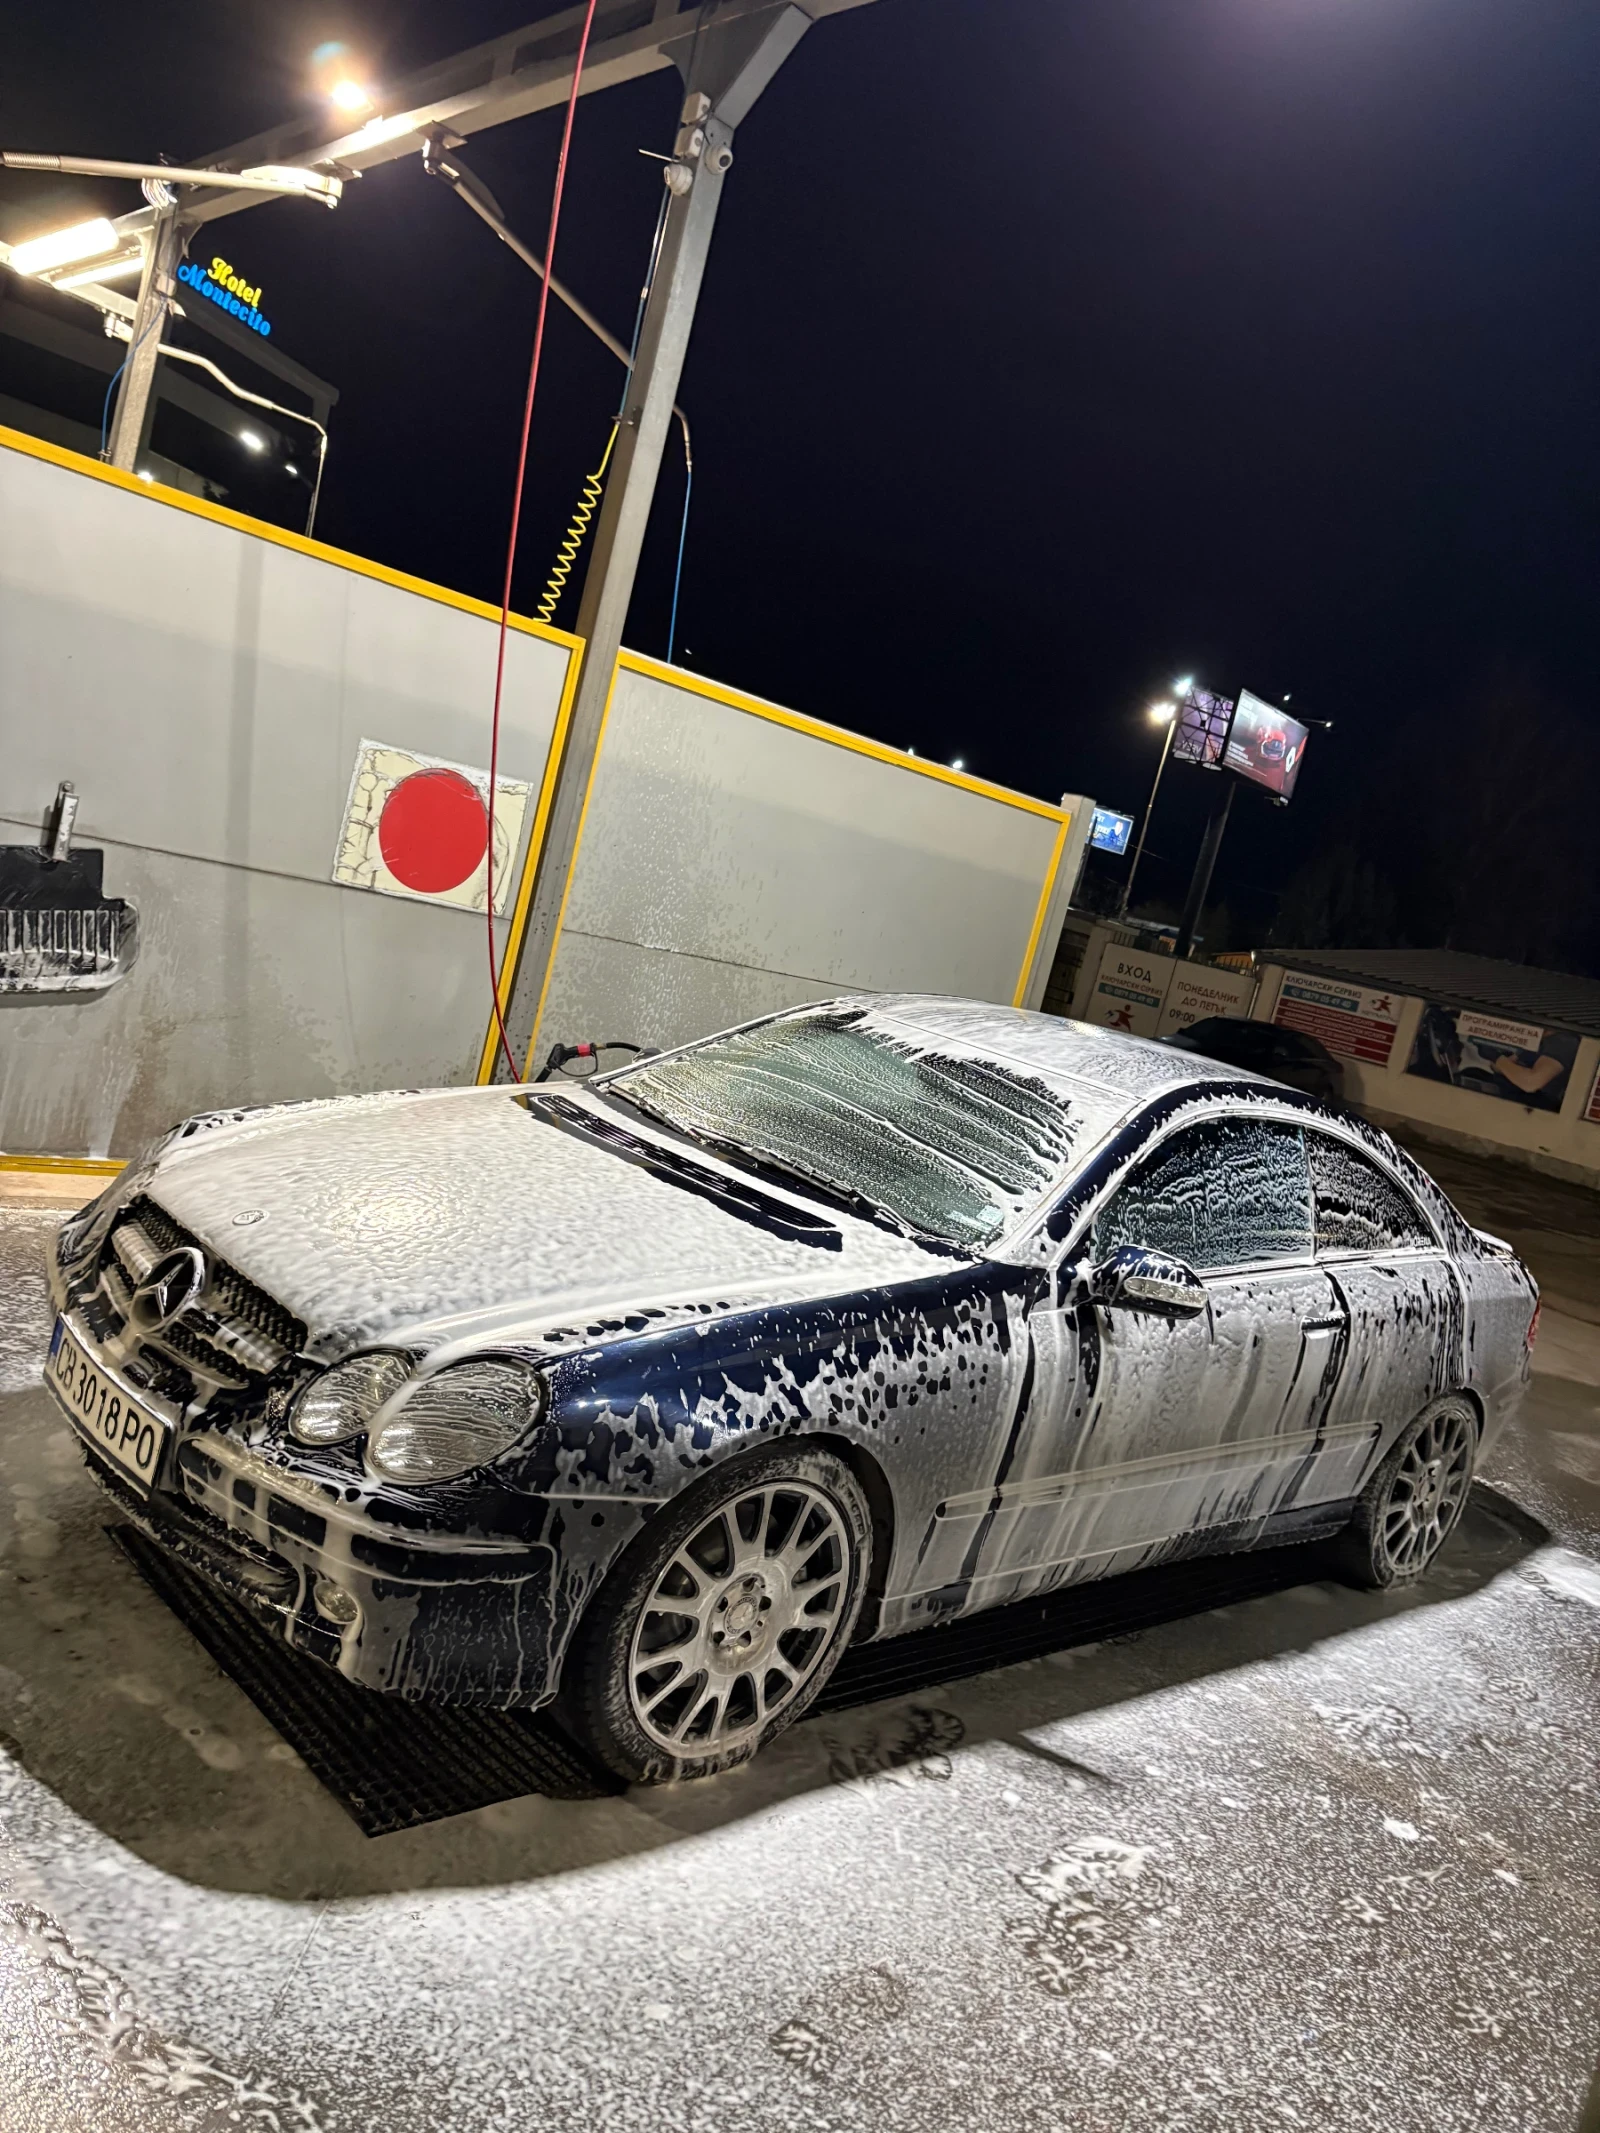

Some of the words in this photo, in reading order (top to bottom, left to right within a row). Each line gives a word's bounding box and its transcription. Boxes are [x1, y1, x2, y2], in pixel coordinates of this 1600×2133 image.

[207, 257, 262, 308] Hotel
[178, 264, 271, 336] Montecito
[1117, 963, 1151, 983] ВХОД
[1177, 981, 1240, 1004] ПОНЕДЕЛНИК
[1286, 975, 1332, 991] КЛЮЧАРСКИ
[1334, 986, 1362, 999] СЕРВИЗ
[1169, 1008, 1196, 1023] 09:00
[1181, 996, 1198, 1007] ДО
[1199, 1000, 1227, 1015] ПЕТЪК
[1462, 1014, 1526, 1035] ПРОГРАМИРАНЕ
[1527, 1029, 1538, 1038] НА
[73, 1362, 121, 1440] 3018
